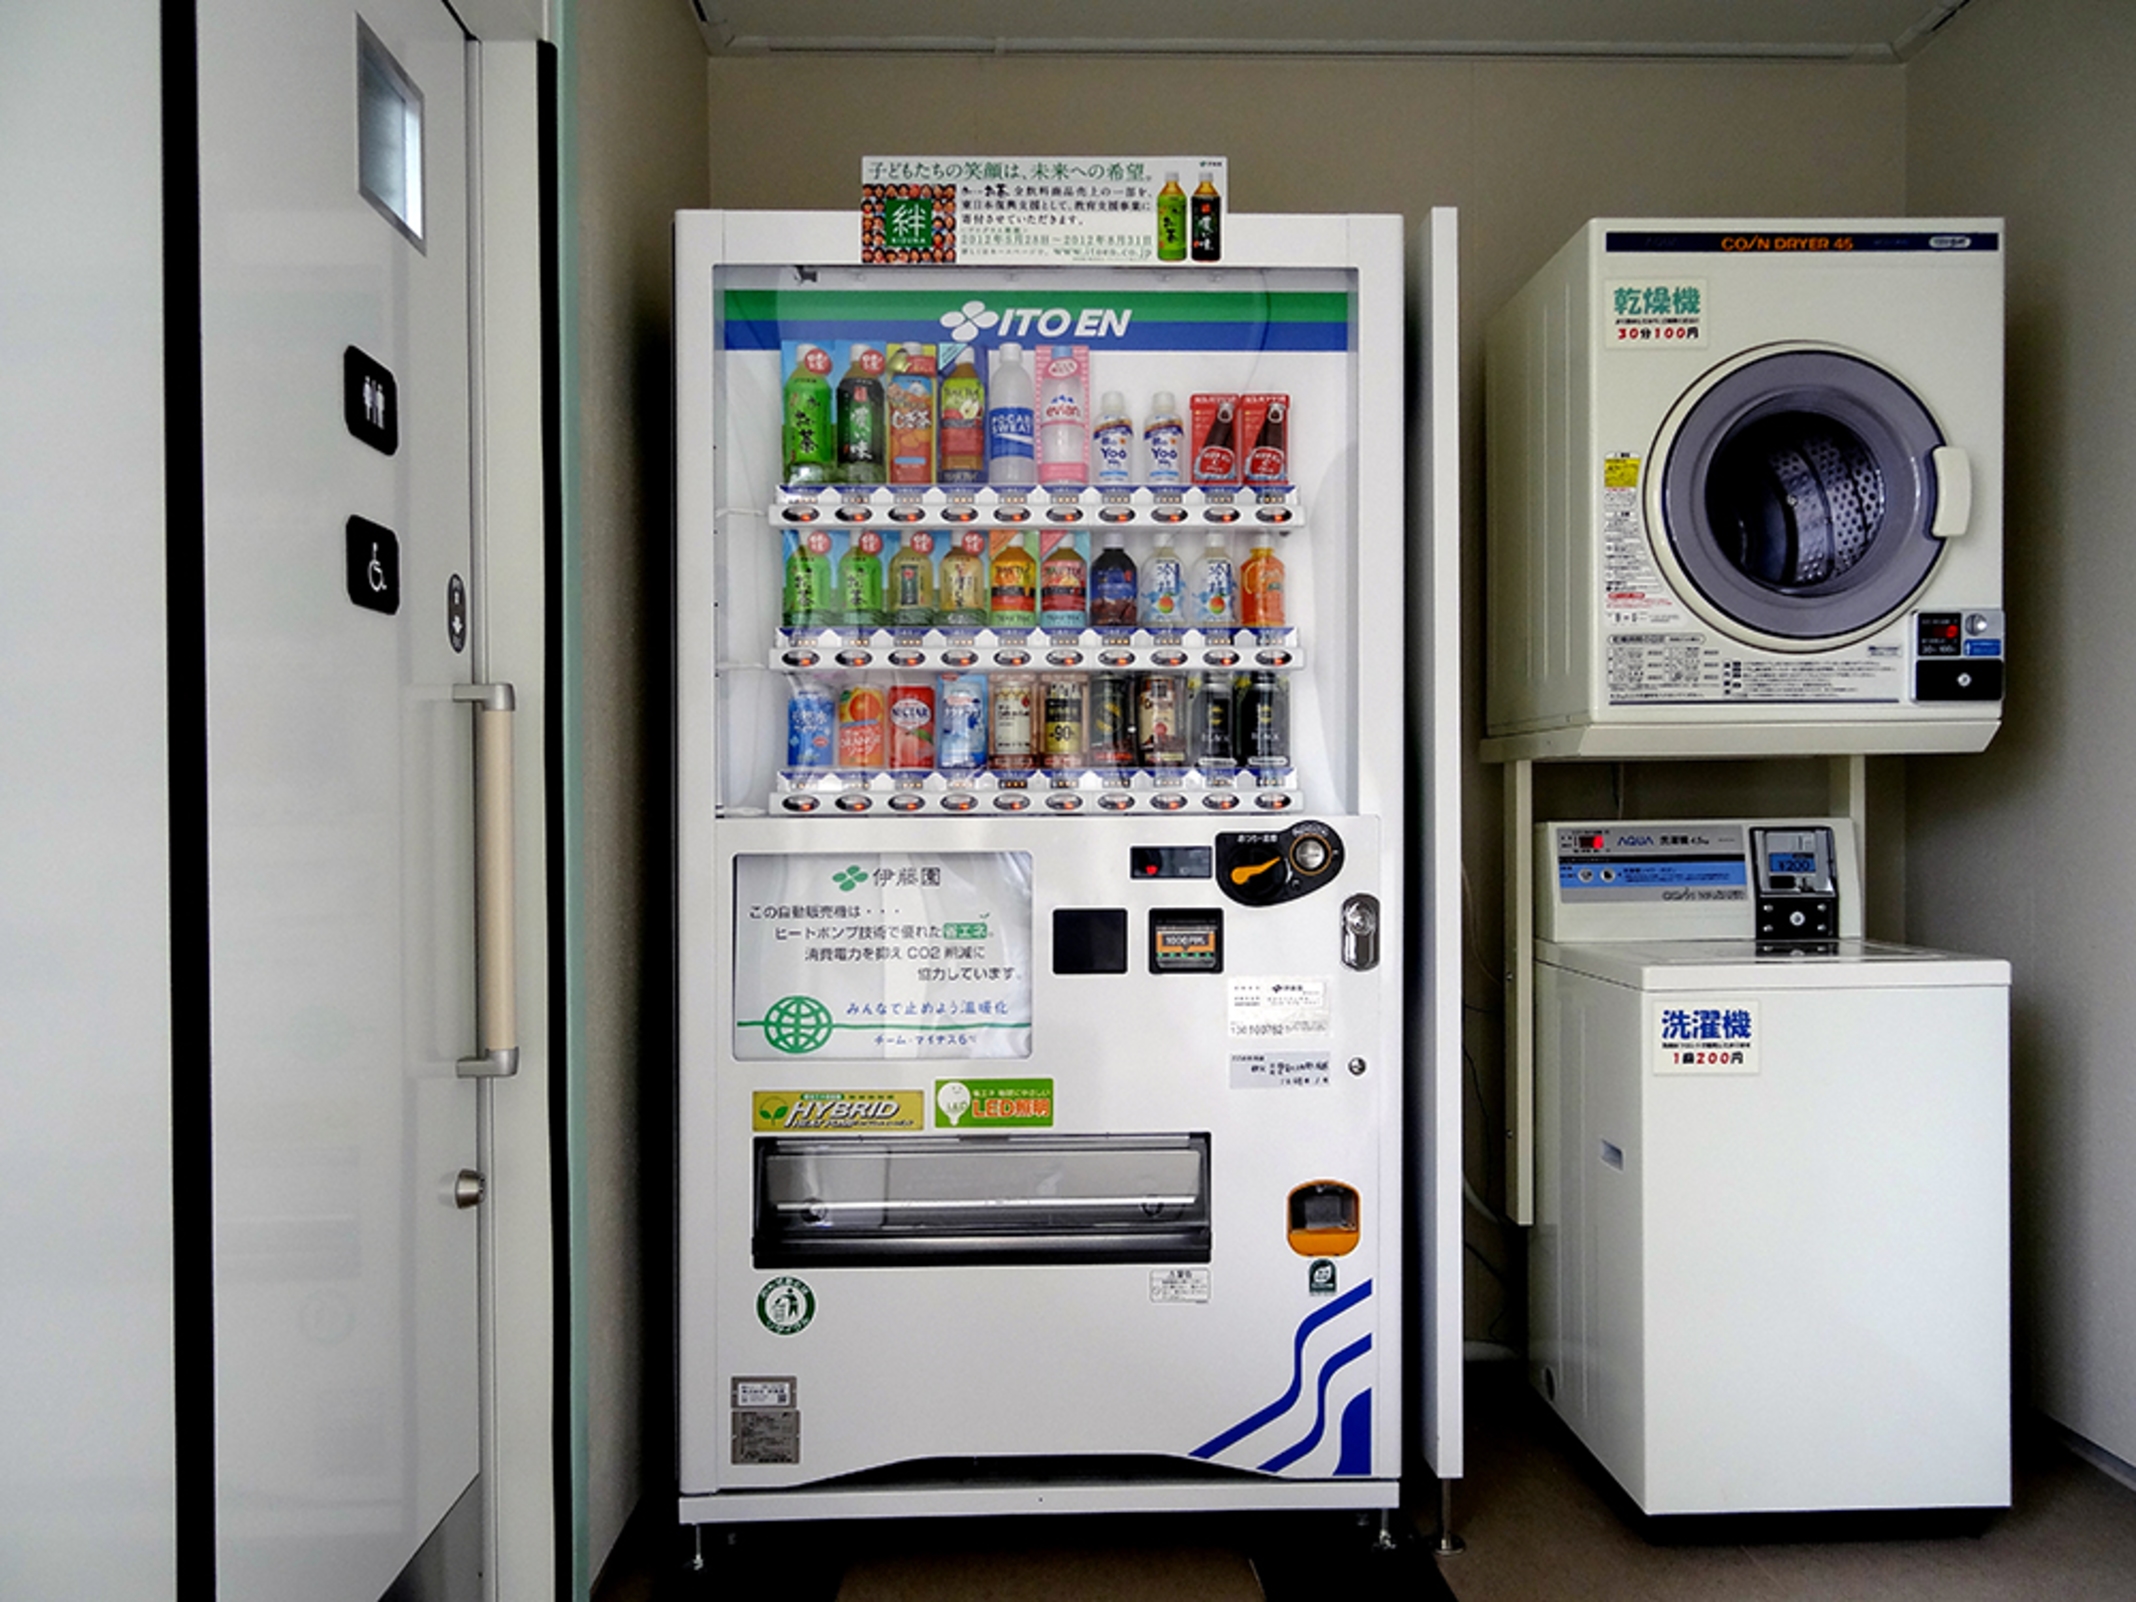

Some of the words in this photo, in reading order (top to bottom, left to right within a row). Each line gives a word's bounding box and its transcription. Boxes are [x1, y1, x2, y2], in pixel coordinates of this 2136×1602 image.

[868, 161, 1152, 182] 子どもたちの笑顔は、未来への希望。
[892, 203, 927, 237] 絆
[1774, 237, 1829, 251] DRYER
[1614, 286, 1700, 315] 乾燥機
[997, 308, 1072, 337] ITO
[1074, 308, 1132, 337] EN
[1618, 327, 1698, 340] 30分100円
[1617, 836, 1654, 846] AQUA
[872, 866, 941, 887] 伊藤園
[906, 947, 941, 961] CO2
[846, 1000, 1009, 1016] みんなで止めよう温暖化
[1661, 1009, 1752, 1039] 洗濯機
[1673, 1051, 1744, 1064] 1回200円
[784, 1100, 900, 1128] HYBRID
[972, 1098, 1050, 1118] LED照明
